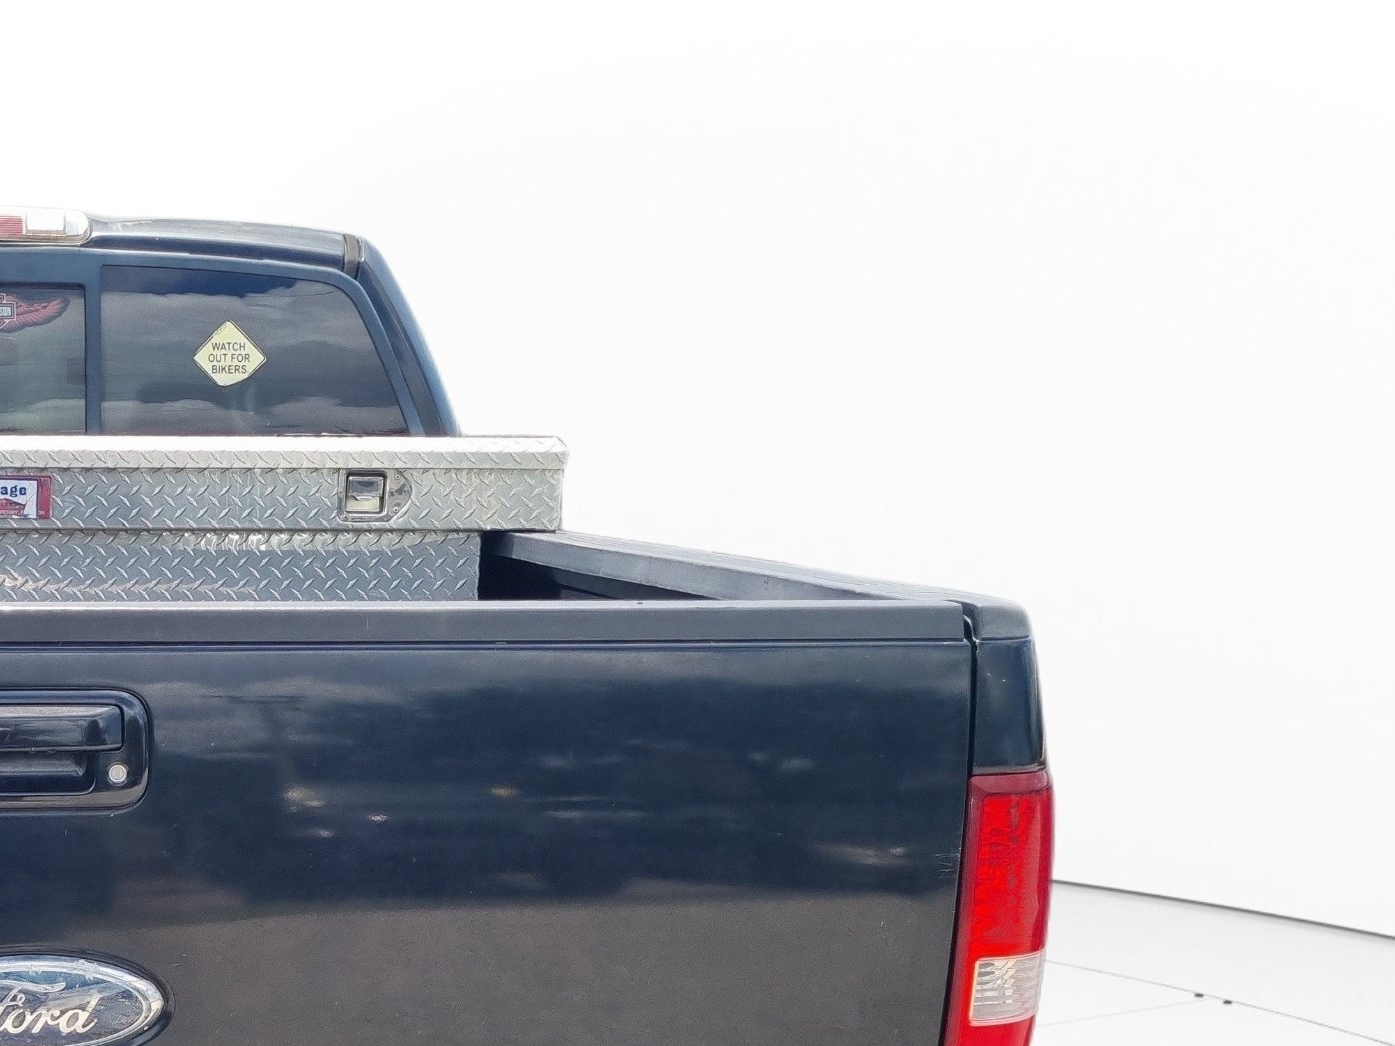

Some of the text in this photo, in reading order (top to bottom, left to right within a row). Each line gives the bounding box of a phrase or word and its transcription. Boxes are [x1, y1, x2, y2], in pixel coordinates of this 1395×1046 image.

[211, 342, 246, 351] WATCH
[208, 353, 251, 363] OUT FOR
